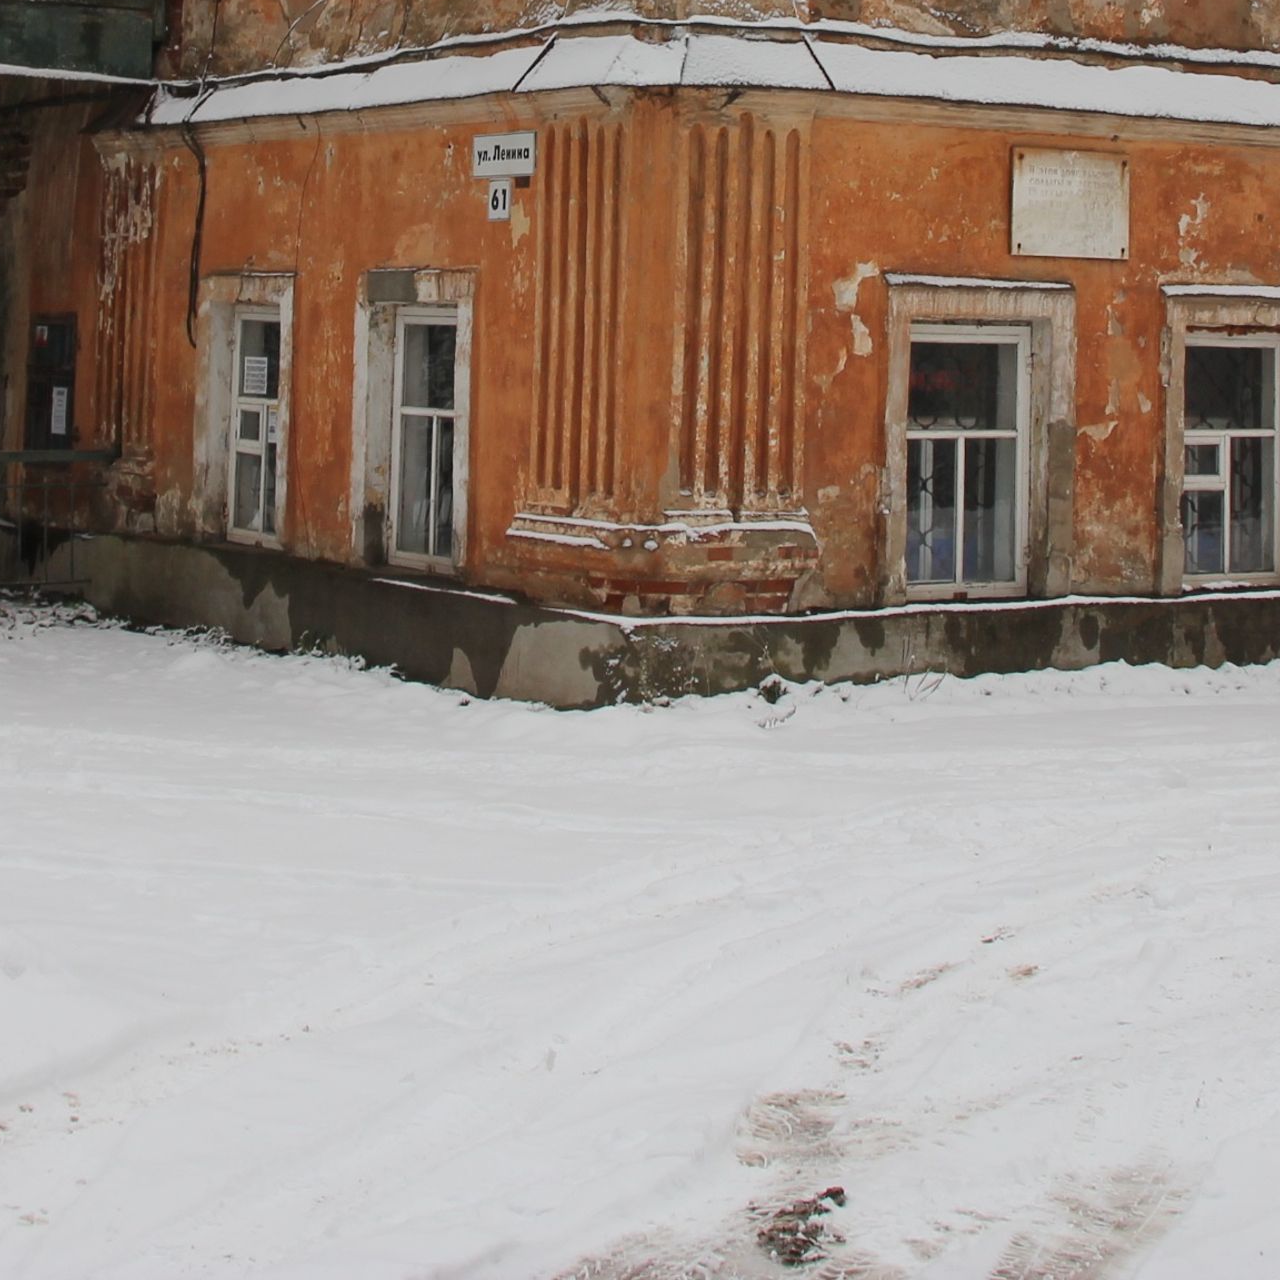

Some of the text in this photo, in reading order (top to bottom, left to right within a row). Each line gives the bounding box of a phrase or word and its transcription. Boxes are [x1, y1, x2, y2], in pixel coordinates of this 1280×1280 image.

[477, 145, 529, 166] ул. Ленина
[491, 189, 507, 210] 61
